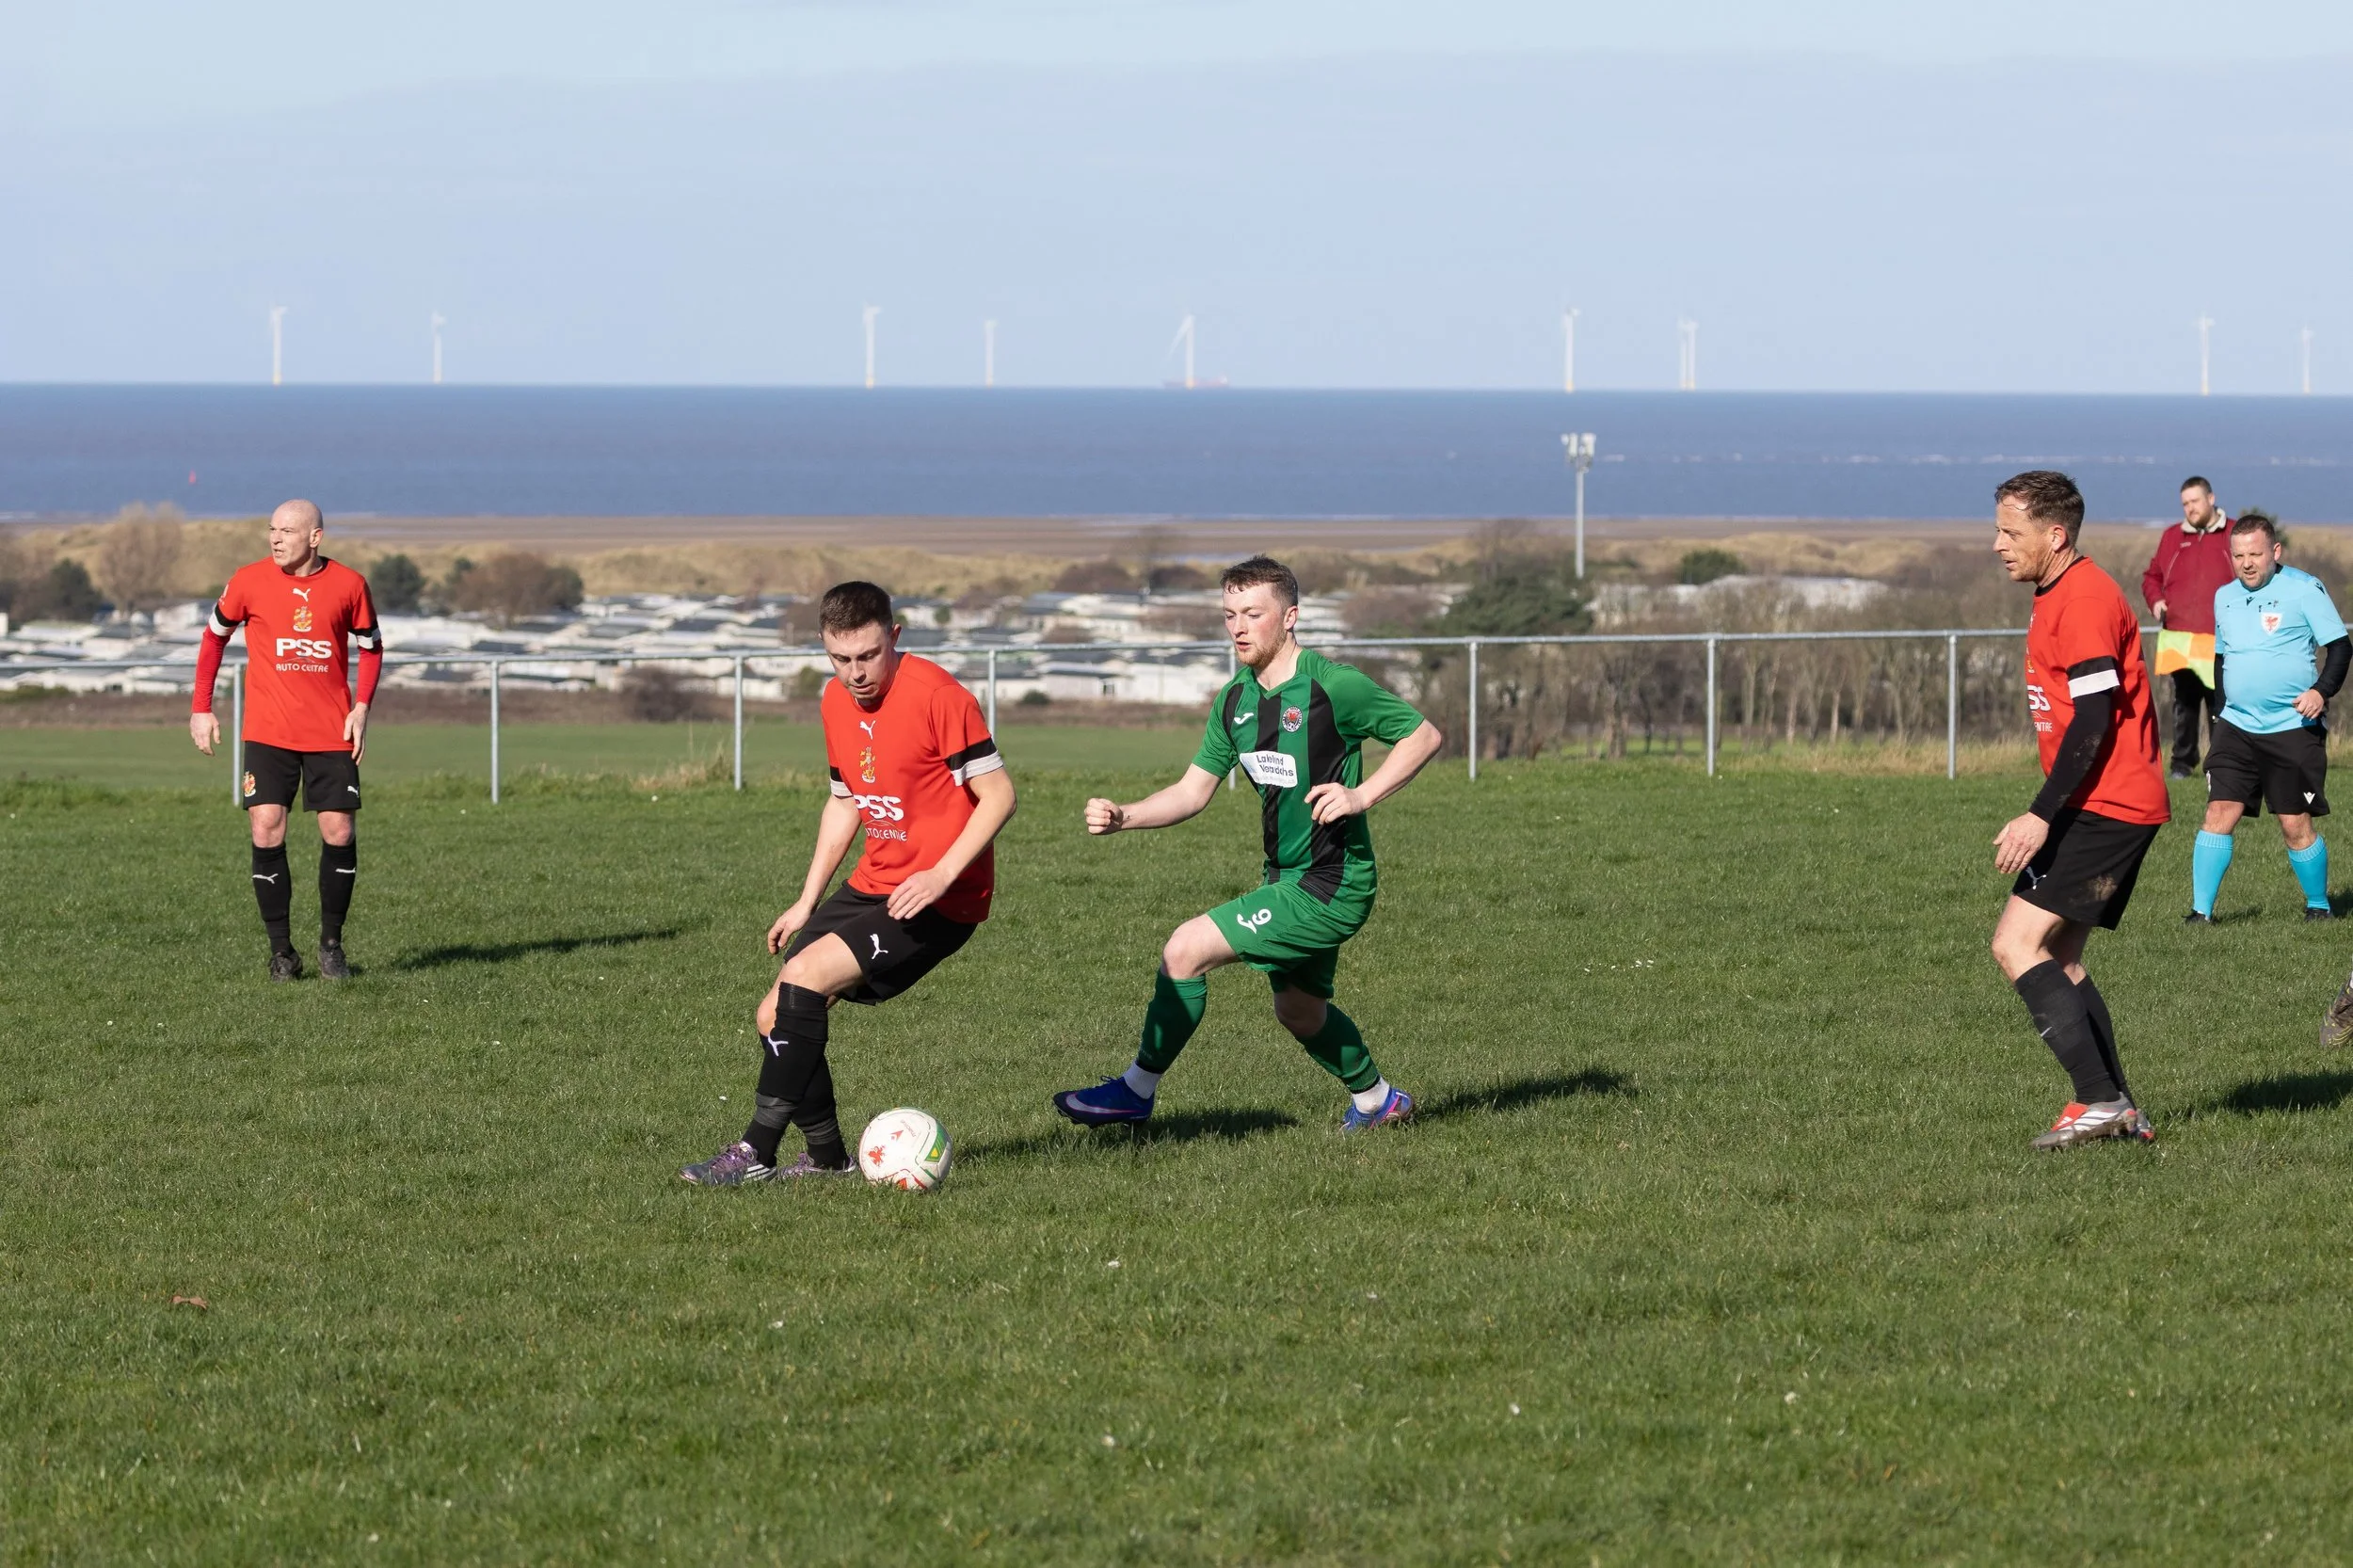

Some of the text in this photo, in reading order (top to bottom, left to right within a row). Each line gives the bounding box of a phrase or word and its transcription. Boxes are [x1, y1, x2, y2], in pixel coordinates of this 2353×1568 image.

[276, 638, 332, 659] PSS
[276, 663, 300, 672] AUTO
[2026, 684, 2051, 711] SS
[1252, 908, 1273, 925] 9
